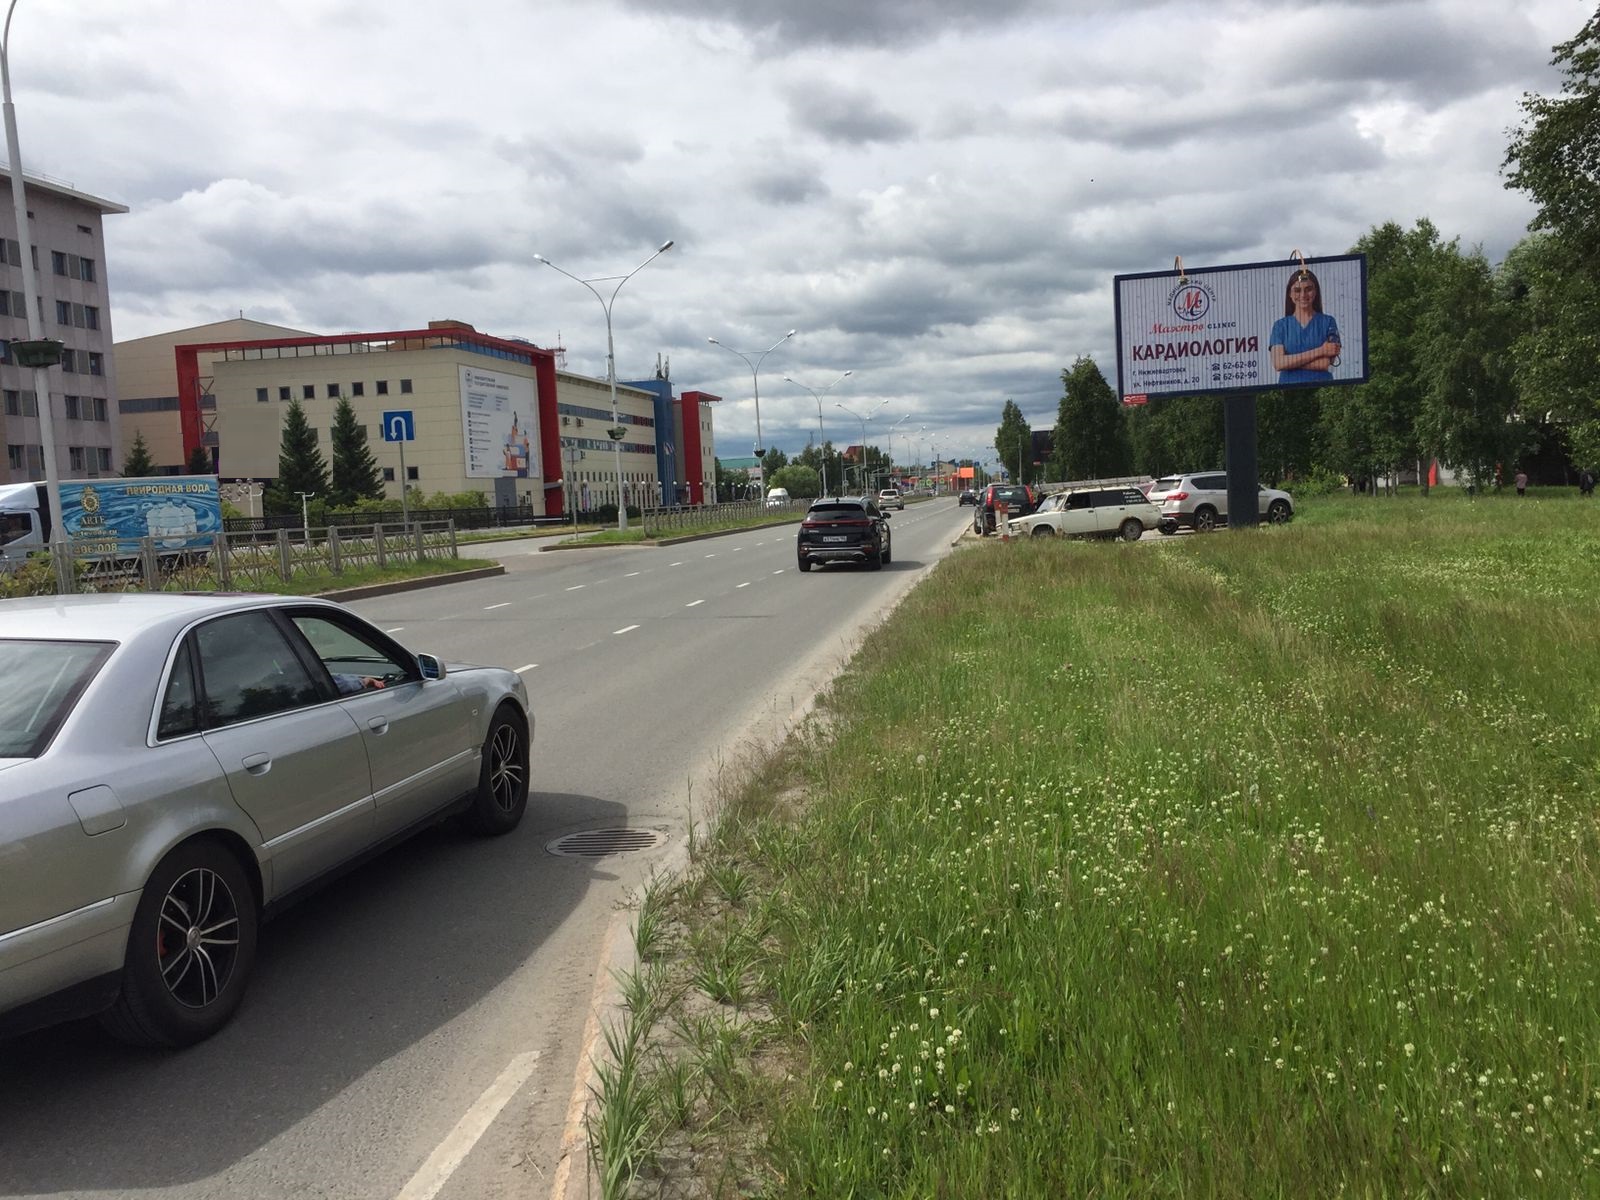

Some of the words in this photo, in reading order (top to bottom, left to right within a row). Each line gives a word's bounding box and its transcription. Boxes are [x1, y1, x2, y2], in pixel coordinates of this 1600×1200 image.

[1149, 322, 1204, 335] Маэстро
[1207, 321, 1237, 329] CLINIC
[1132, 336, 1258, 361] КАРДИОЛОГИЯ
[1222, 360, 1257, 370] 62-62-80
[1138, 367, 1187, 376] Нижневартовск
[1223, 370, 1258, 381] 62-62-90
[126, 484, 184, 496] ПРИРОДНАЯ
[186, 483, 211, 494] ВОДА
[81, 514, 106, 525] ARTE
